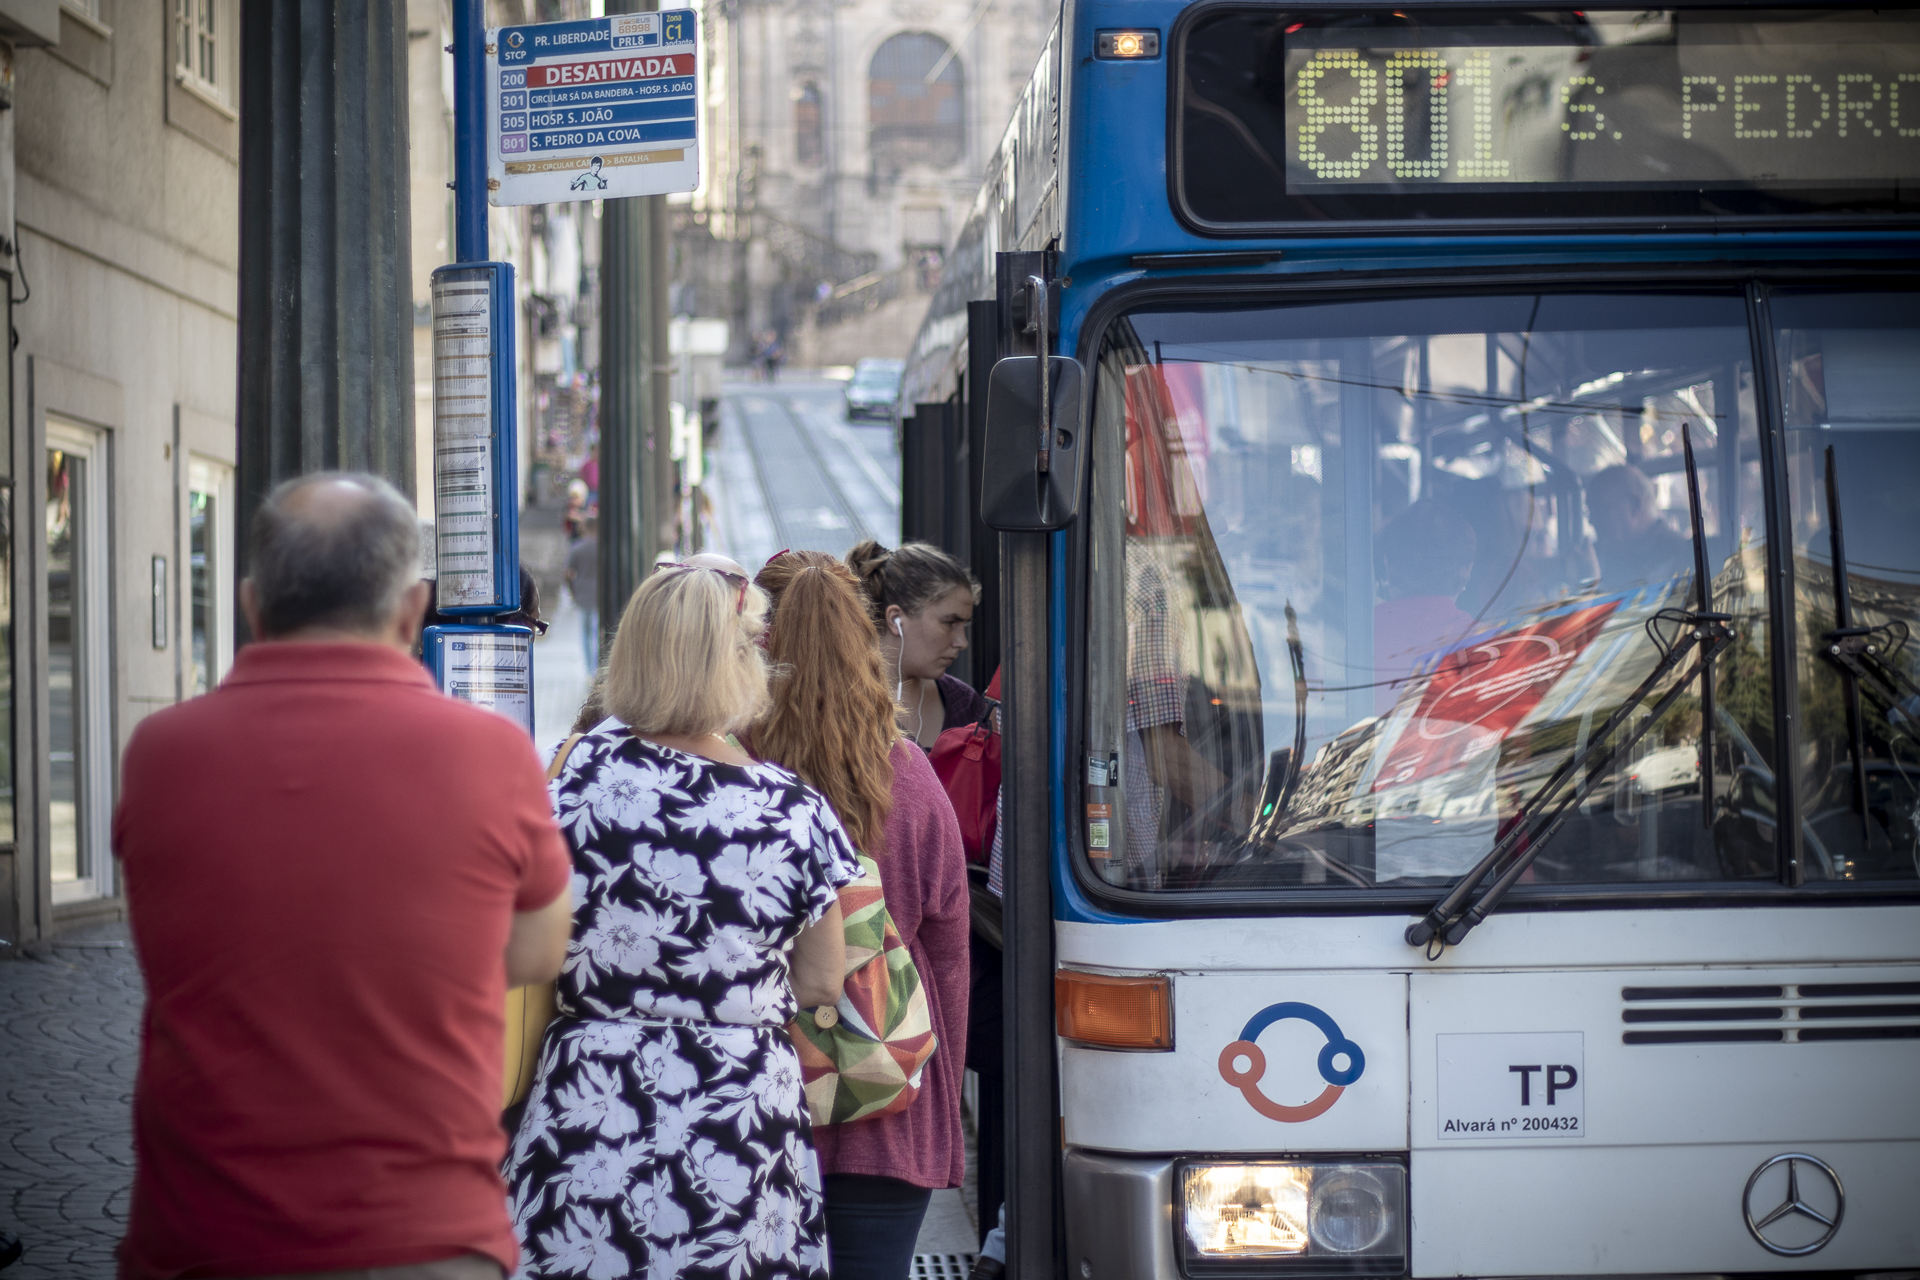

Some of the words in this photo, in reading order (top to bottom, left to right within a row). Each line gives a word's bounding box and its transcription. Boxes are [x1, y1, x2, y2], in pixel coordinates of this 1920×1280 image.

[666, 15, 682, 23] Zona
[618, 23, 651, 34] 68998
[666, 24, 682, 40] C1
[535, 36, 551, 47] PR.
[553, 30, 610, 45] LIBERDADE
[618, 36, 645, 47] PRL8
[505, 50, 527, 61] STCP
[546, 57, 677, 85] DESATIVADA
[502, 74, 525, 86] 200
[502, 95, 524, 107] 301
[531, 93, 568, 104] CIRCULAR
[569, 91, 580, 101] SÁ
[581, 91, 593, 100] DA
[594, 88, 634, 99] BANDEIRA
[640, 86, 661, 95] HOSP.
[663, 84, 670, 93] S.
[671, 82, 693, 93] JOÃO
[503, 116, 525, 129] 305
[532, 113, 564, 127] HOSP.
[568, 112, 578, 124] S.
[581, 107, 613, 123] JOÃO
[1298, 50, 1510, 179] 801
[1560, 76, 1623, 141] S.
[1682, 73, 1920, 139] PEDRO
[503, 137, 525, 150] 801
[532, 136, 542, 148] S.
[545, 133, 583, 147] PEDRO
[587, 131, 605, 143] DA
[608, 128, 641, 142] COVA
[527, 164, 536, 172] 22
[542, 161, 574, 171] CIRCULAR
[614, 154, 650, 165] BATALHA
[1508, 1064, 1578, 1106] TP
[1444, 1117, 1496, 1133] Alvará
[1501, 1117, 1518, 1131] nº
[1522, 1116, 1579, 1131] 200432
